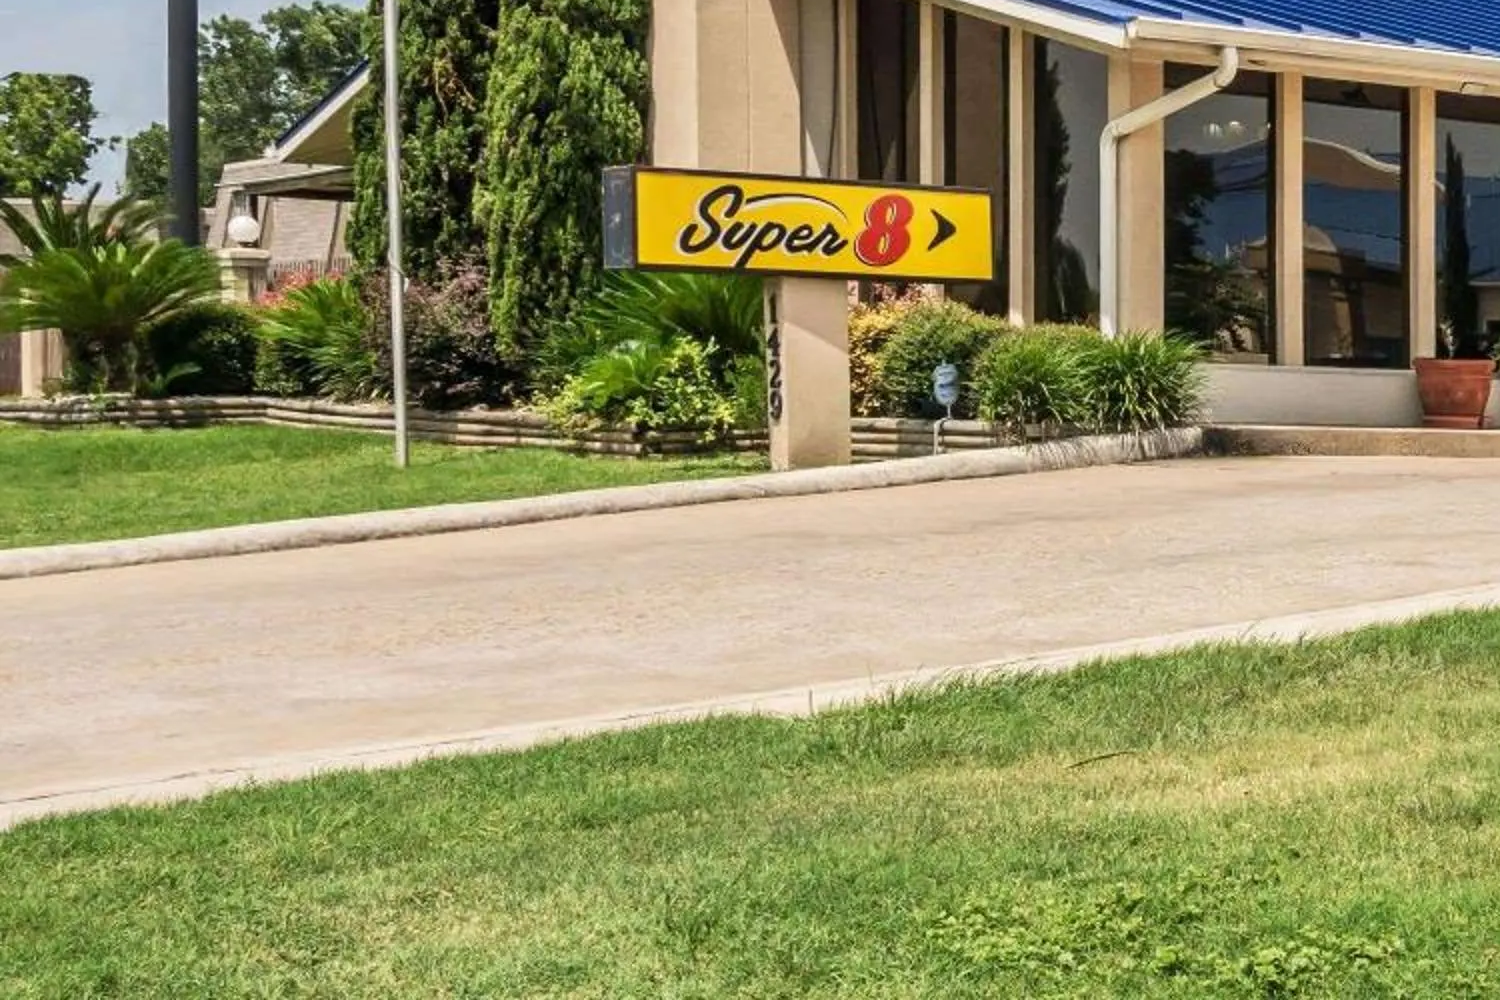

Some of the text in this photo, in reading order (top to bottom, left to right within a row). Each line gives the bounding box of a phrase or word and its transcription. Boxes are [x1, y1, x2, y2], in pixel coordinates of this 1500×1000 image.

[679, 184, 914, 268] Super 8
[767, 292, 783, 422] 1429
